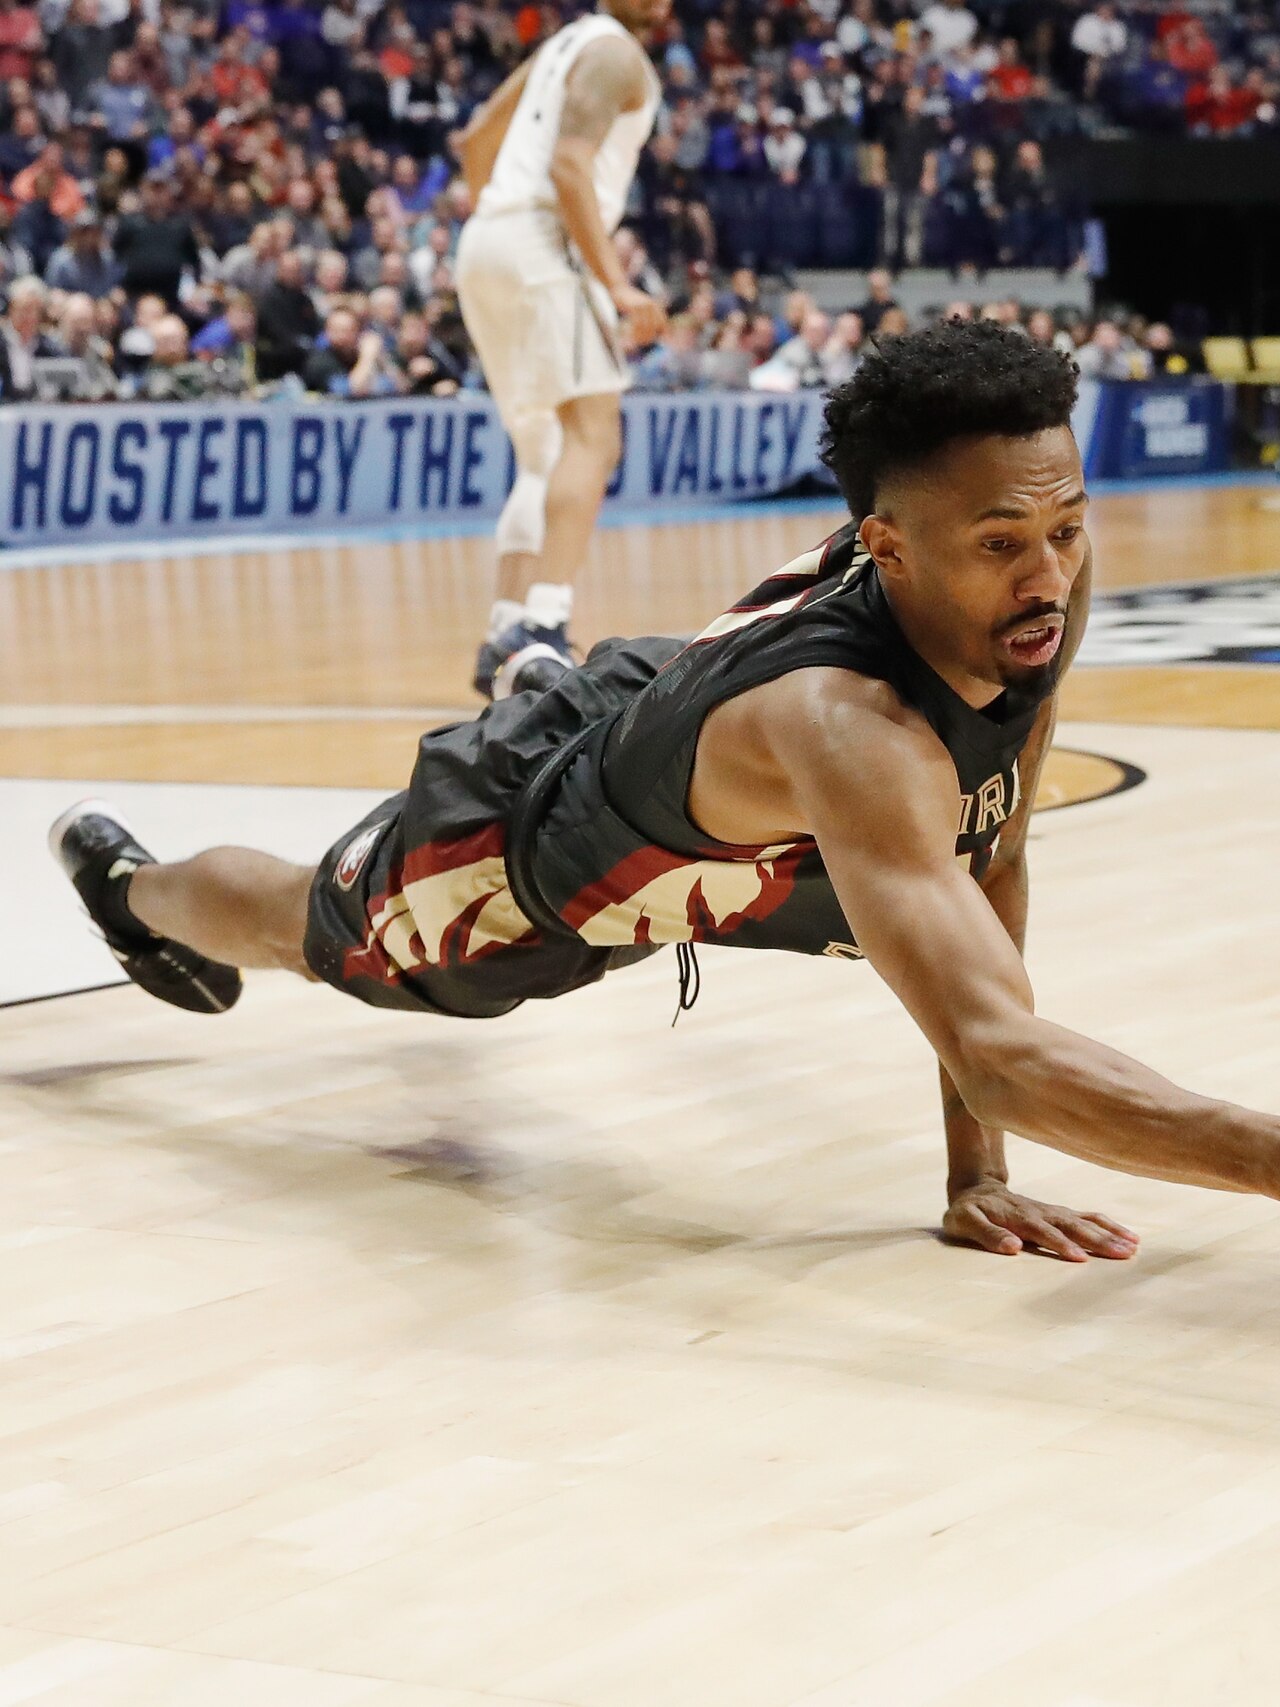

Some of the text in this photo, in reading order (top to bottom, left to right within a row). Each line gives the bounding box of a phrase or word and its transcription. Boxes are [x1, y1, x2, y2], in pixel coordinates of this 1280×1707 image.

[11, 416, 268, 531] HOSTED
[289, 415, 365, 516] BY
[387, 412, 489, 511] THE
[648, 402, 807, 497] VALLEY
